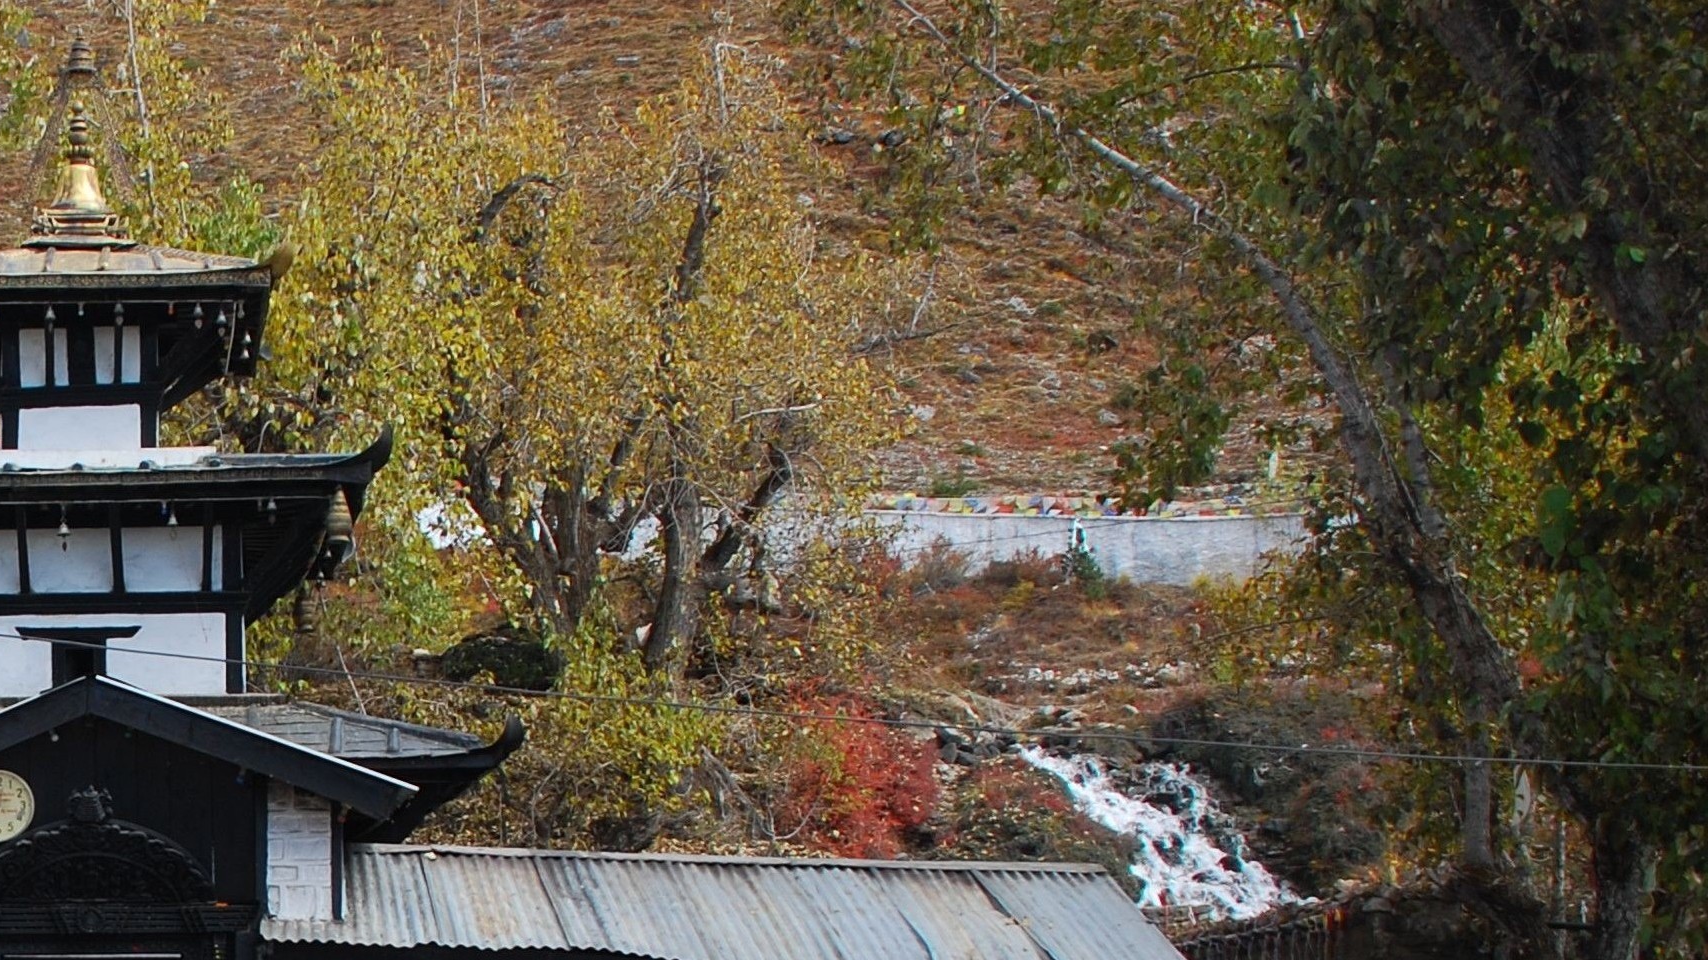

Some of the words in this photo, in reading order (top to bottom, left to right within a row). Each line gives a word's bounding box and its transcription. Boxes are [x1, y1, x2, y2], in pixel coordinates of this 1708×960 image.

[16, 788, 23, 798] 2
[20, 800, 26, 810] 3
[7, 822, 14, 832] 5
